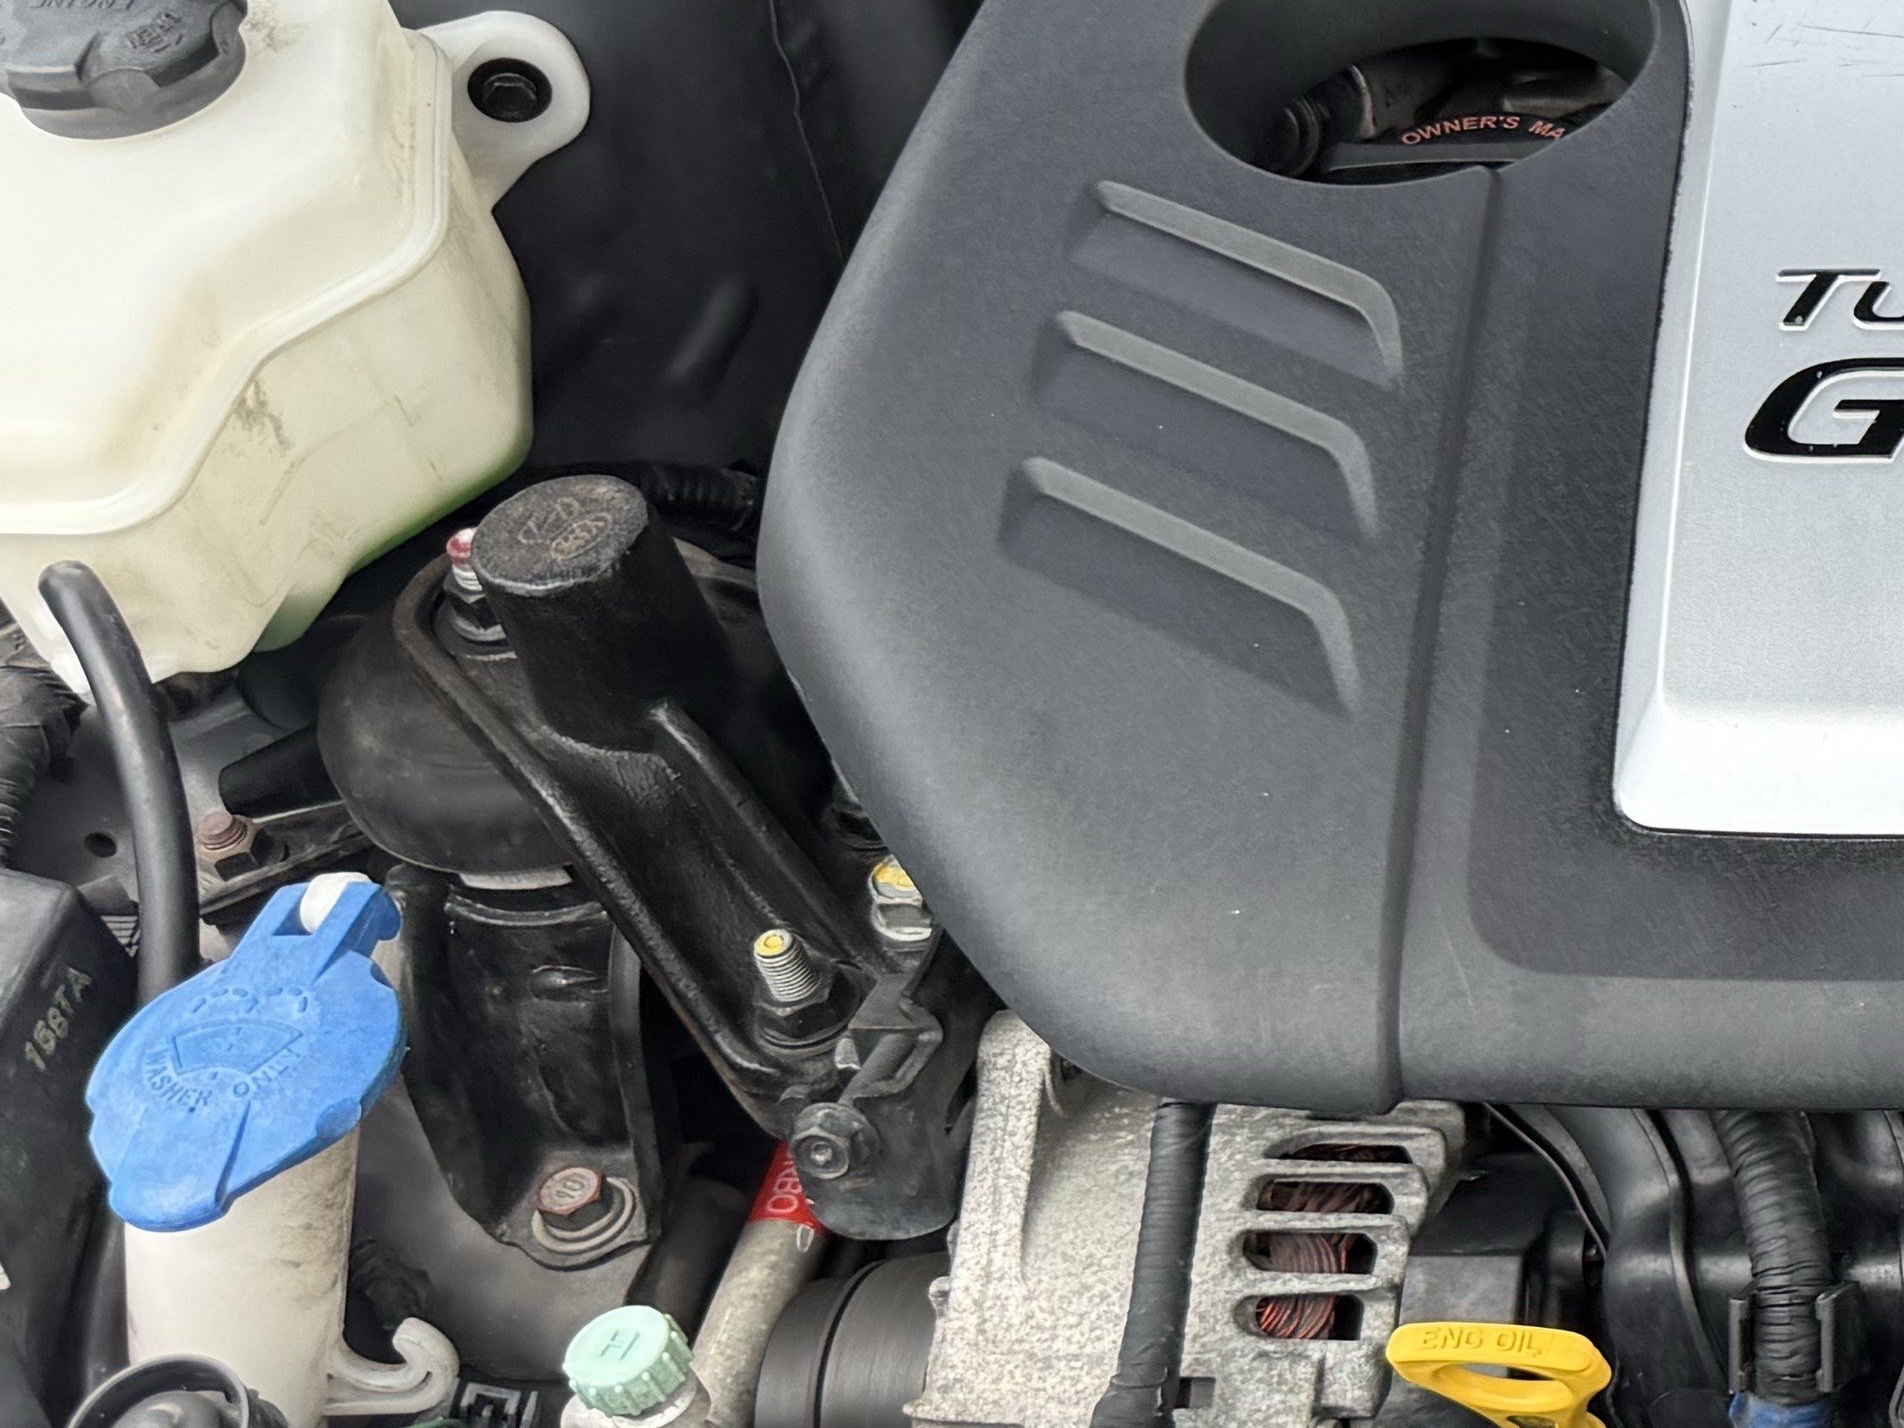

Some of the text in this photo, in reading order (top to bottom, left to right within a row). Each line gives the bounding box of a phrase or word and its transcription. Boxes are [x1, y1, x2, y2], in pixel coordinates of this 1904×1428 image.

[1402, 116, 1520, 145] OWNER'S
[144, 1049, 213, 1107] WASHER
[1421, 1327, 1541, 1355] ENG OIL
